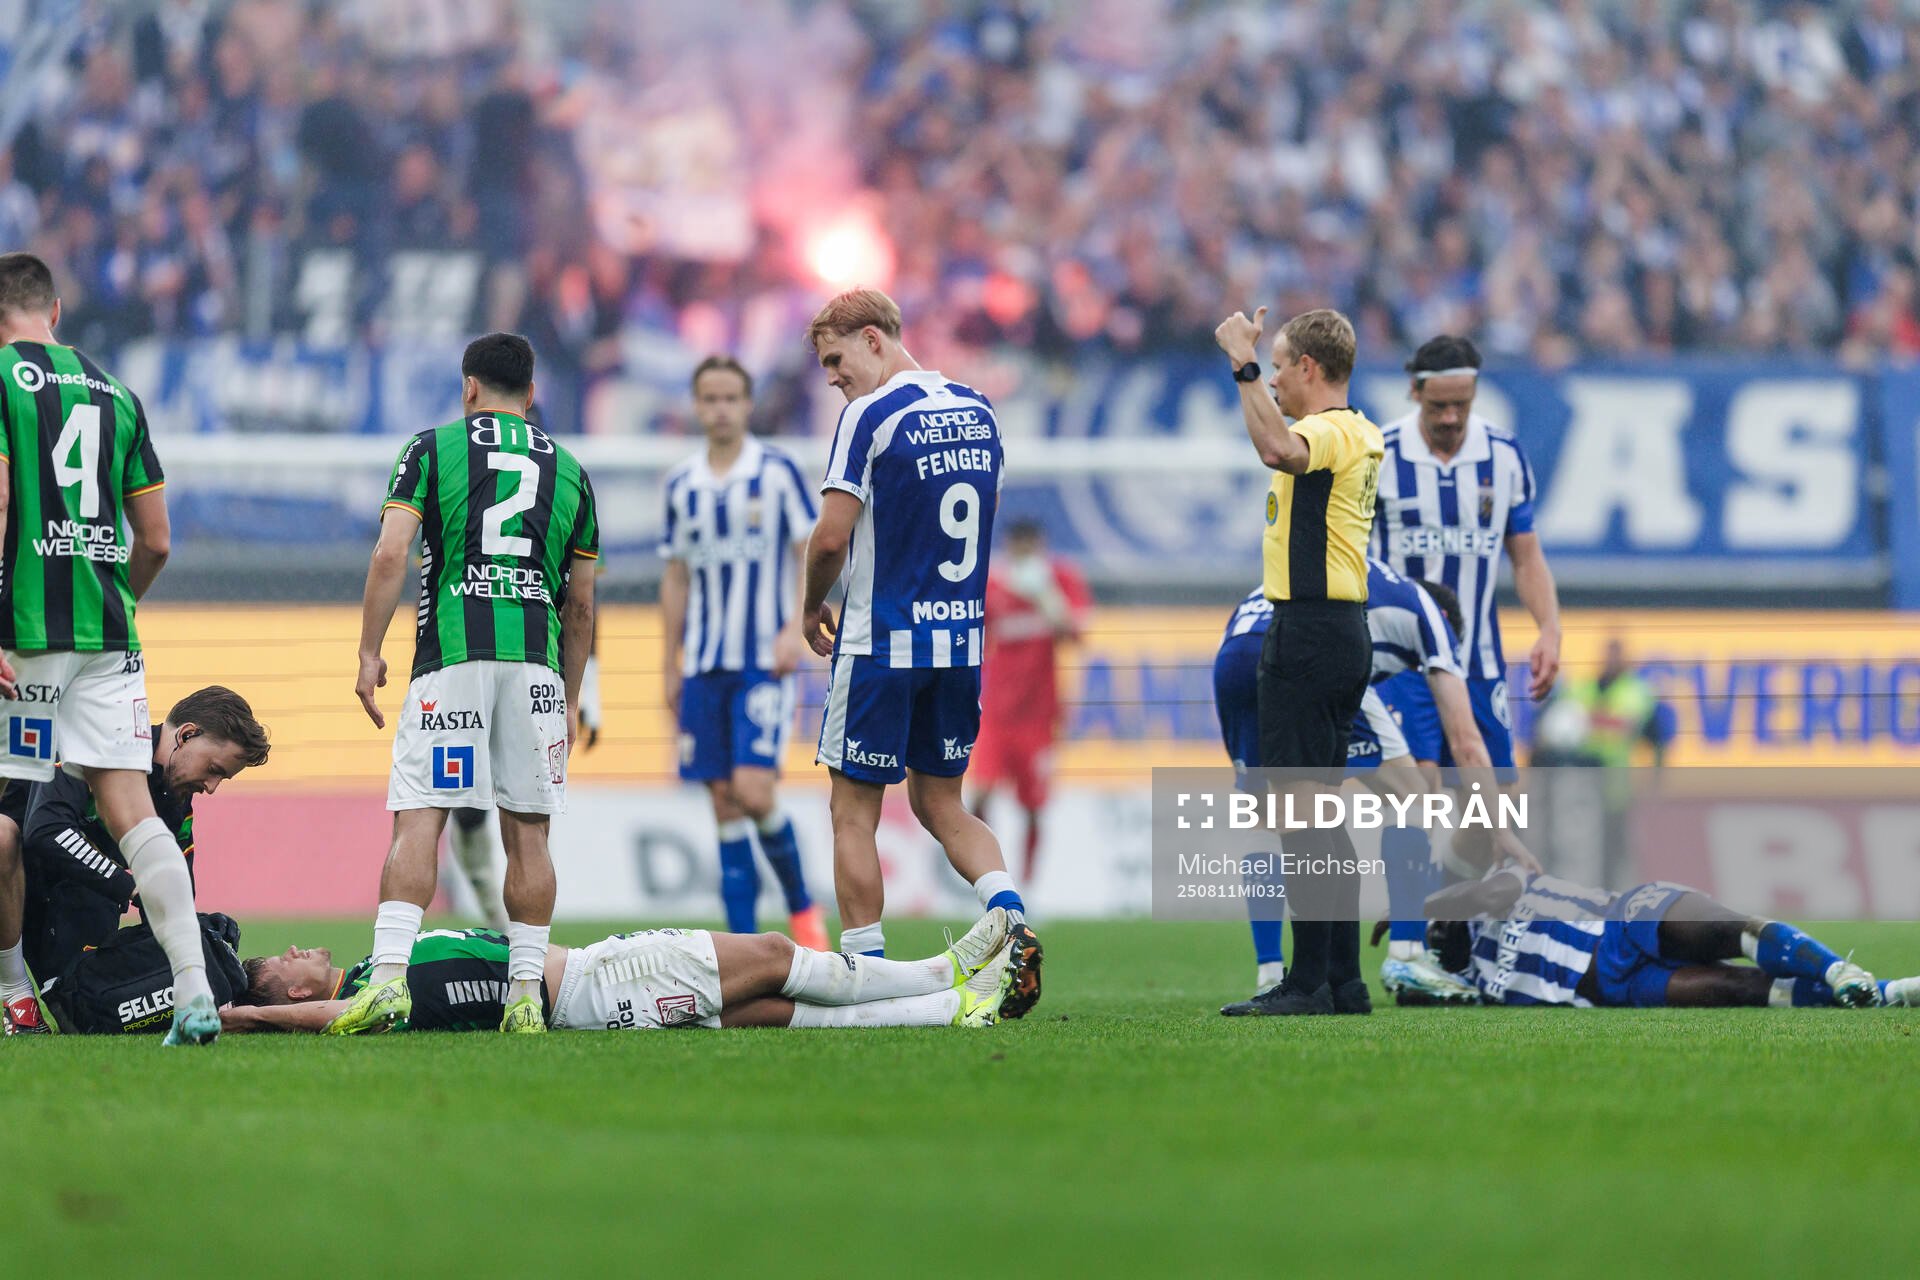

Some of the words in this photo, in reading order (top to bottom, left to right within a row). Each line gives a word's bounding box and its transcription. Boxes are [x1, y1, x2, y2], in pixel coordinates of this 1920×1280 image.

[919, 411, 979, 428] NORDIC
[906, 425, 991, 446] WELLNESS
[52, 403, 100, 518] 4
[916, 448, 992, 481] FENGER
[481, 451, 540, 557] 2
[937, 482, 980, 583] 9
[32, 538, 128, 564] WELNESS
[467, 564, 544, 586] NORDIC
[449, 581, 556, 610] WELLNES
[420, 710, 485, 731] RASTA
[846, 747, 899, 768] RASTA
[1484, 902, 1537, 1000] ERNEKE
[117, 986, 175, 1024] SELEC
[123, 1009, 176, 1033] PROFCAR
